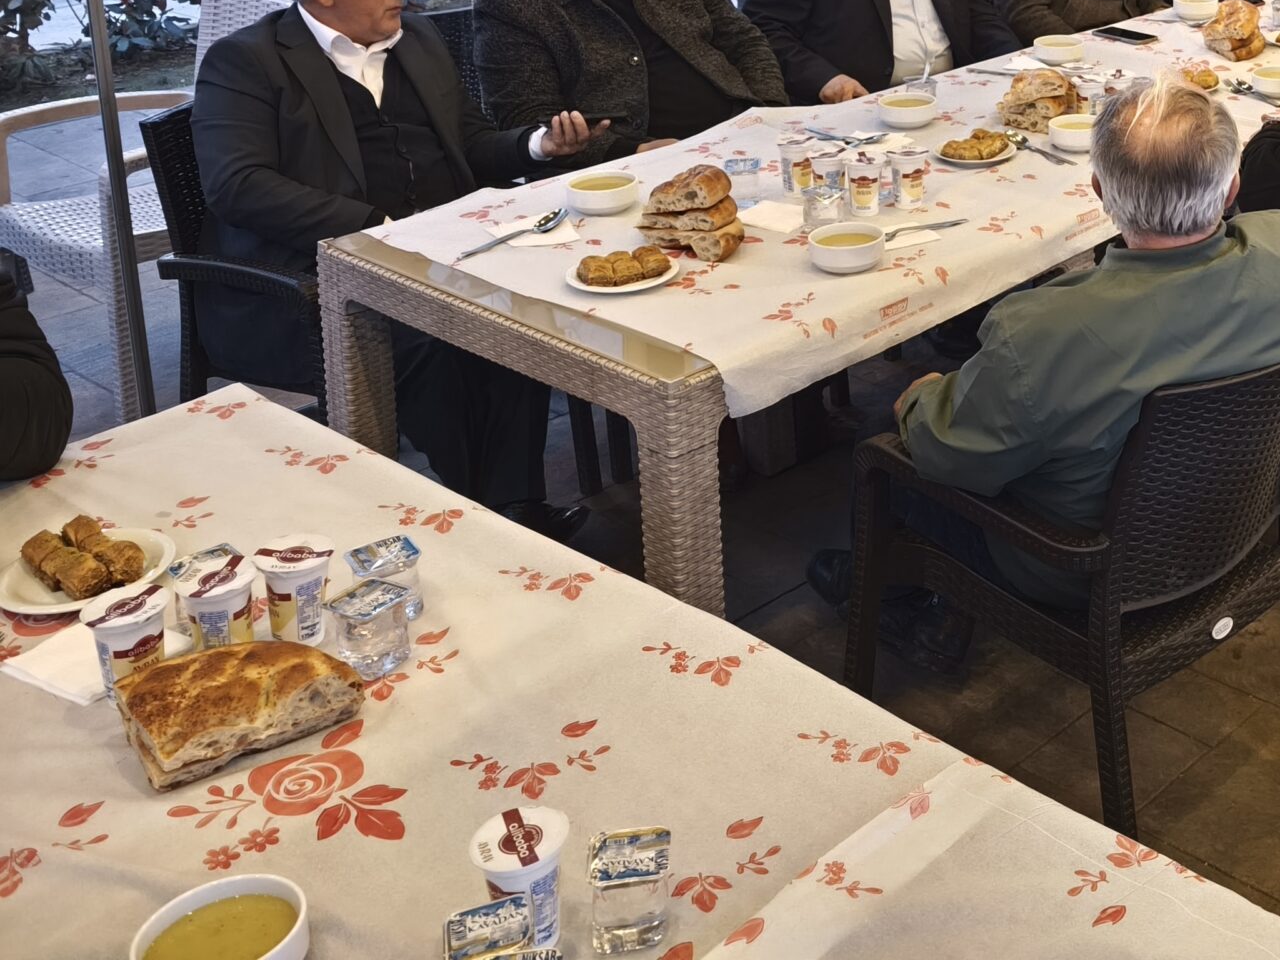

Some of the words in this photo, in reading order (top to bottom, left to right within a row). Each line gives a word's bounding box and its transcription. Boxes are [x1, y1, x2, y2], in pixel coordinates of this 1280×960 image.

[271, 550, 318, 560] alibaba
[105, 593, 150, 621] alibaba
[508, 822, 530, 859] alibaba
